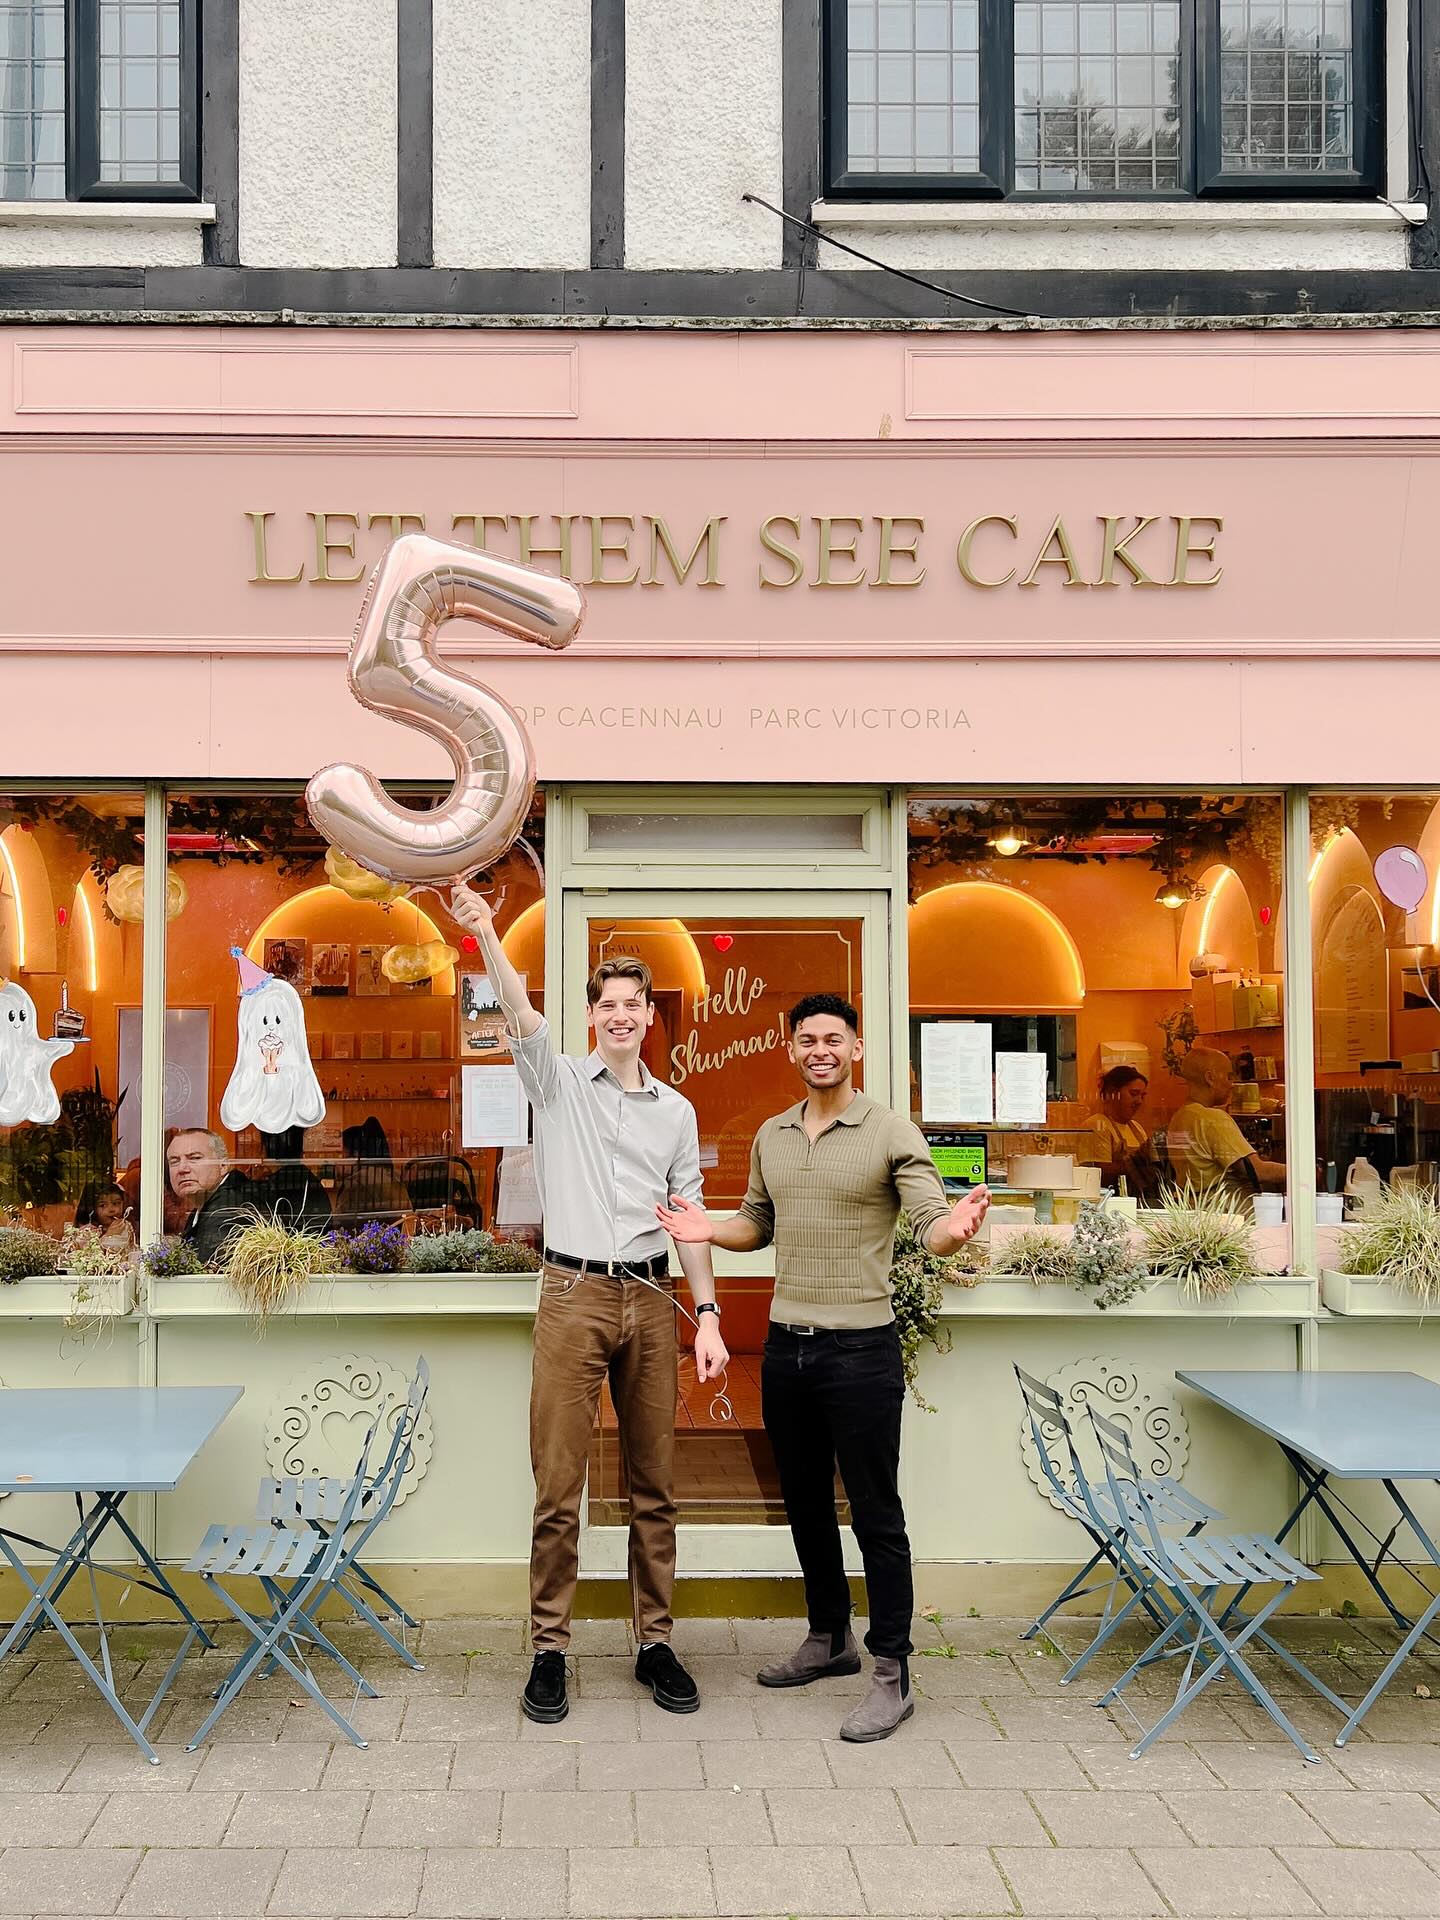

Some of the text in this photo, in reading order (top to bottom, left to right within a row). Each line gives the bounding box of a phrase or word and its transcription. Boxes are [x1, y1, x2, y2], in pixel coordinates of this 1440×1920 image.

[758, 514, 928, 587] SEE
[956, 513, 1224, 586] CAKE
[511, 706, 972, 729] OP CACENNAU PARC VICTORIA
[692, 966, 767, 1022] Hello
[471, 1028, 495, 1041] AFTER
[670, 1012, 785, 1085] Shwmae!
